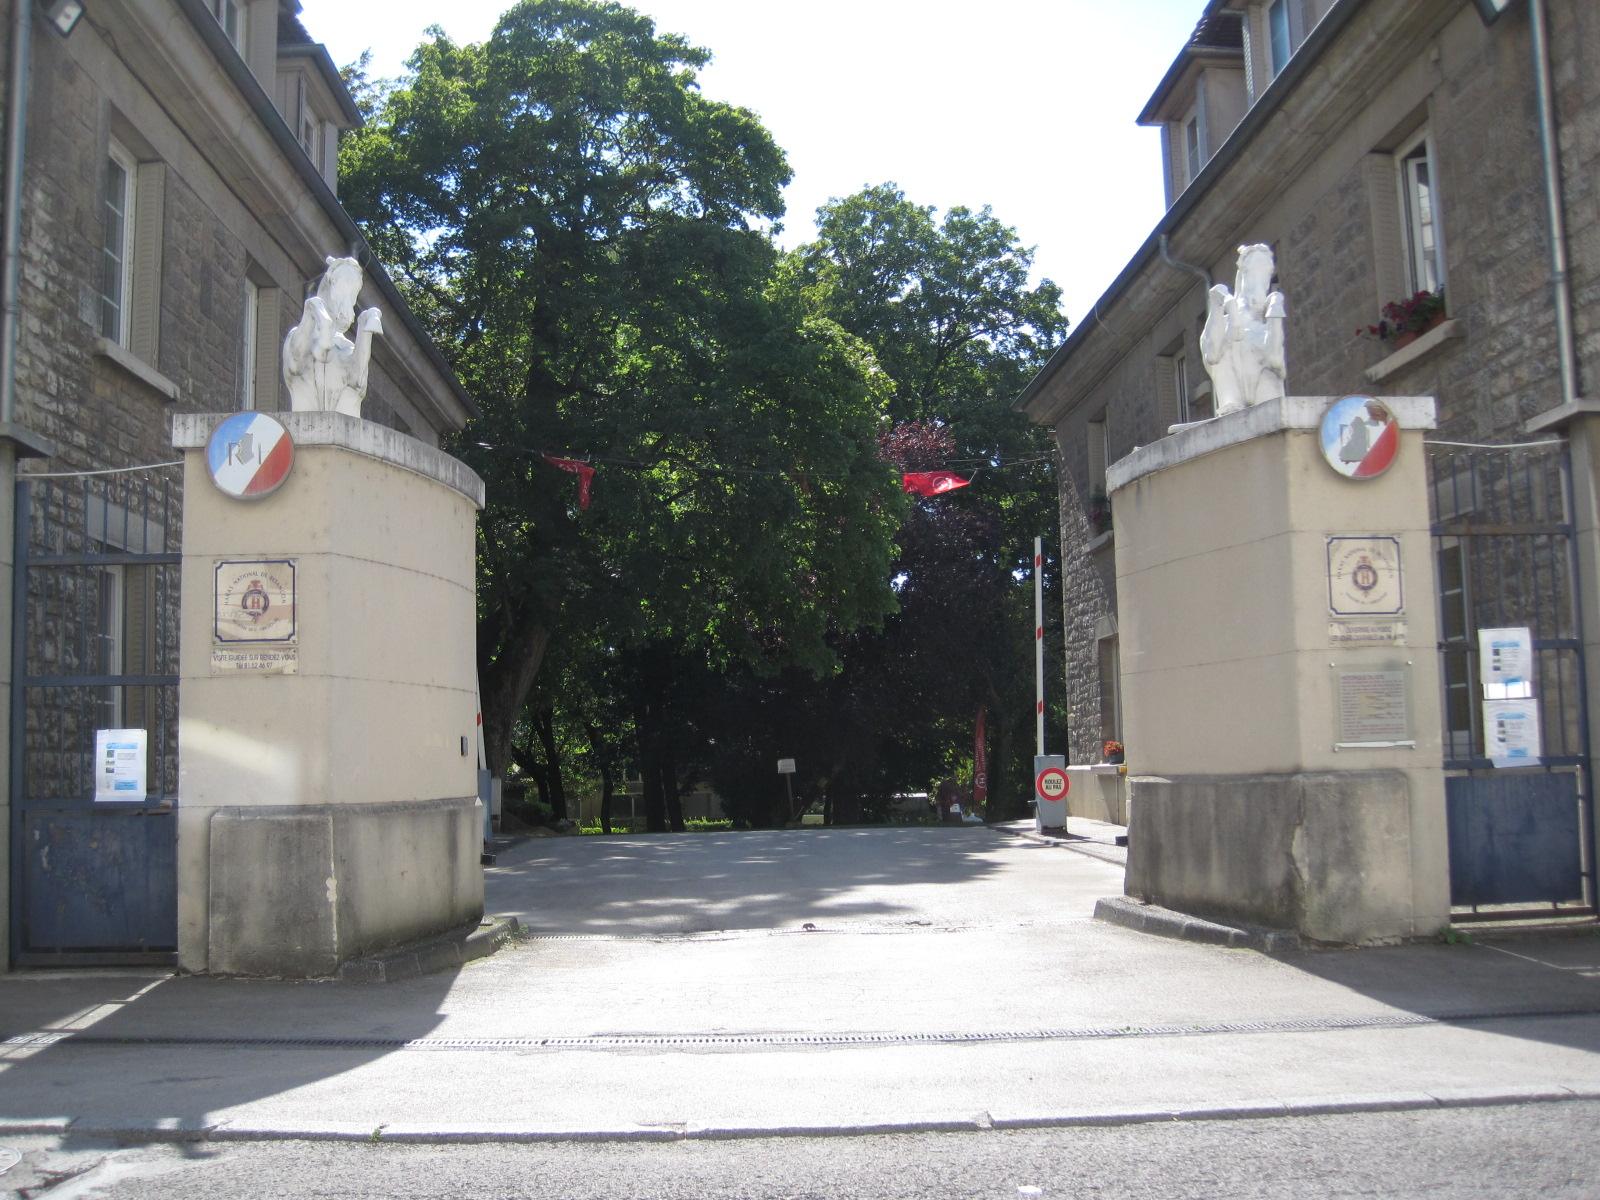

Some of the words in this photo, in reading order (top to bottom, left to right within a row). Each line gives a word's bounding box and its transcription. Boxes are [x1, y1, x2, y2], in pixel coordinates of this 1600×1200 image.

[224, 586, 234, 606] HARAS
[233, 571, 259, 585] NATIONAL
[251, 595, 261, 609] H
